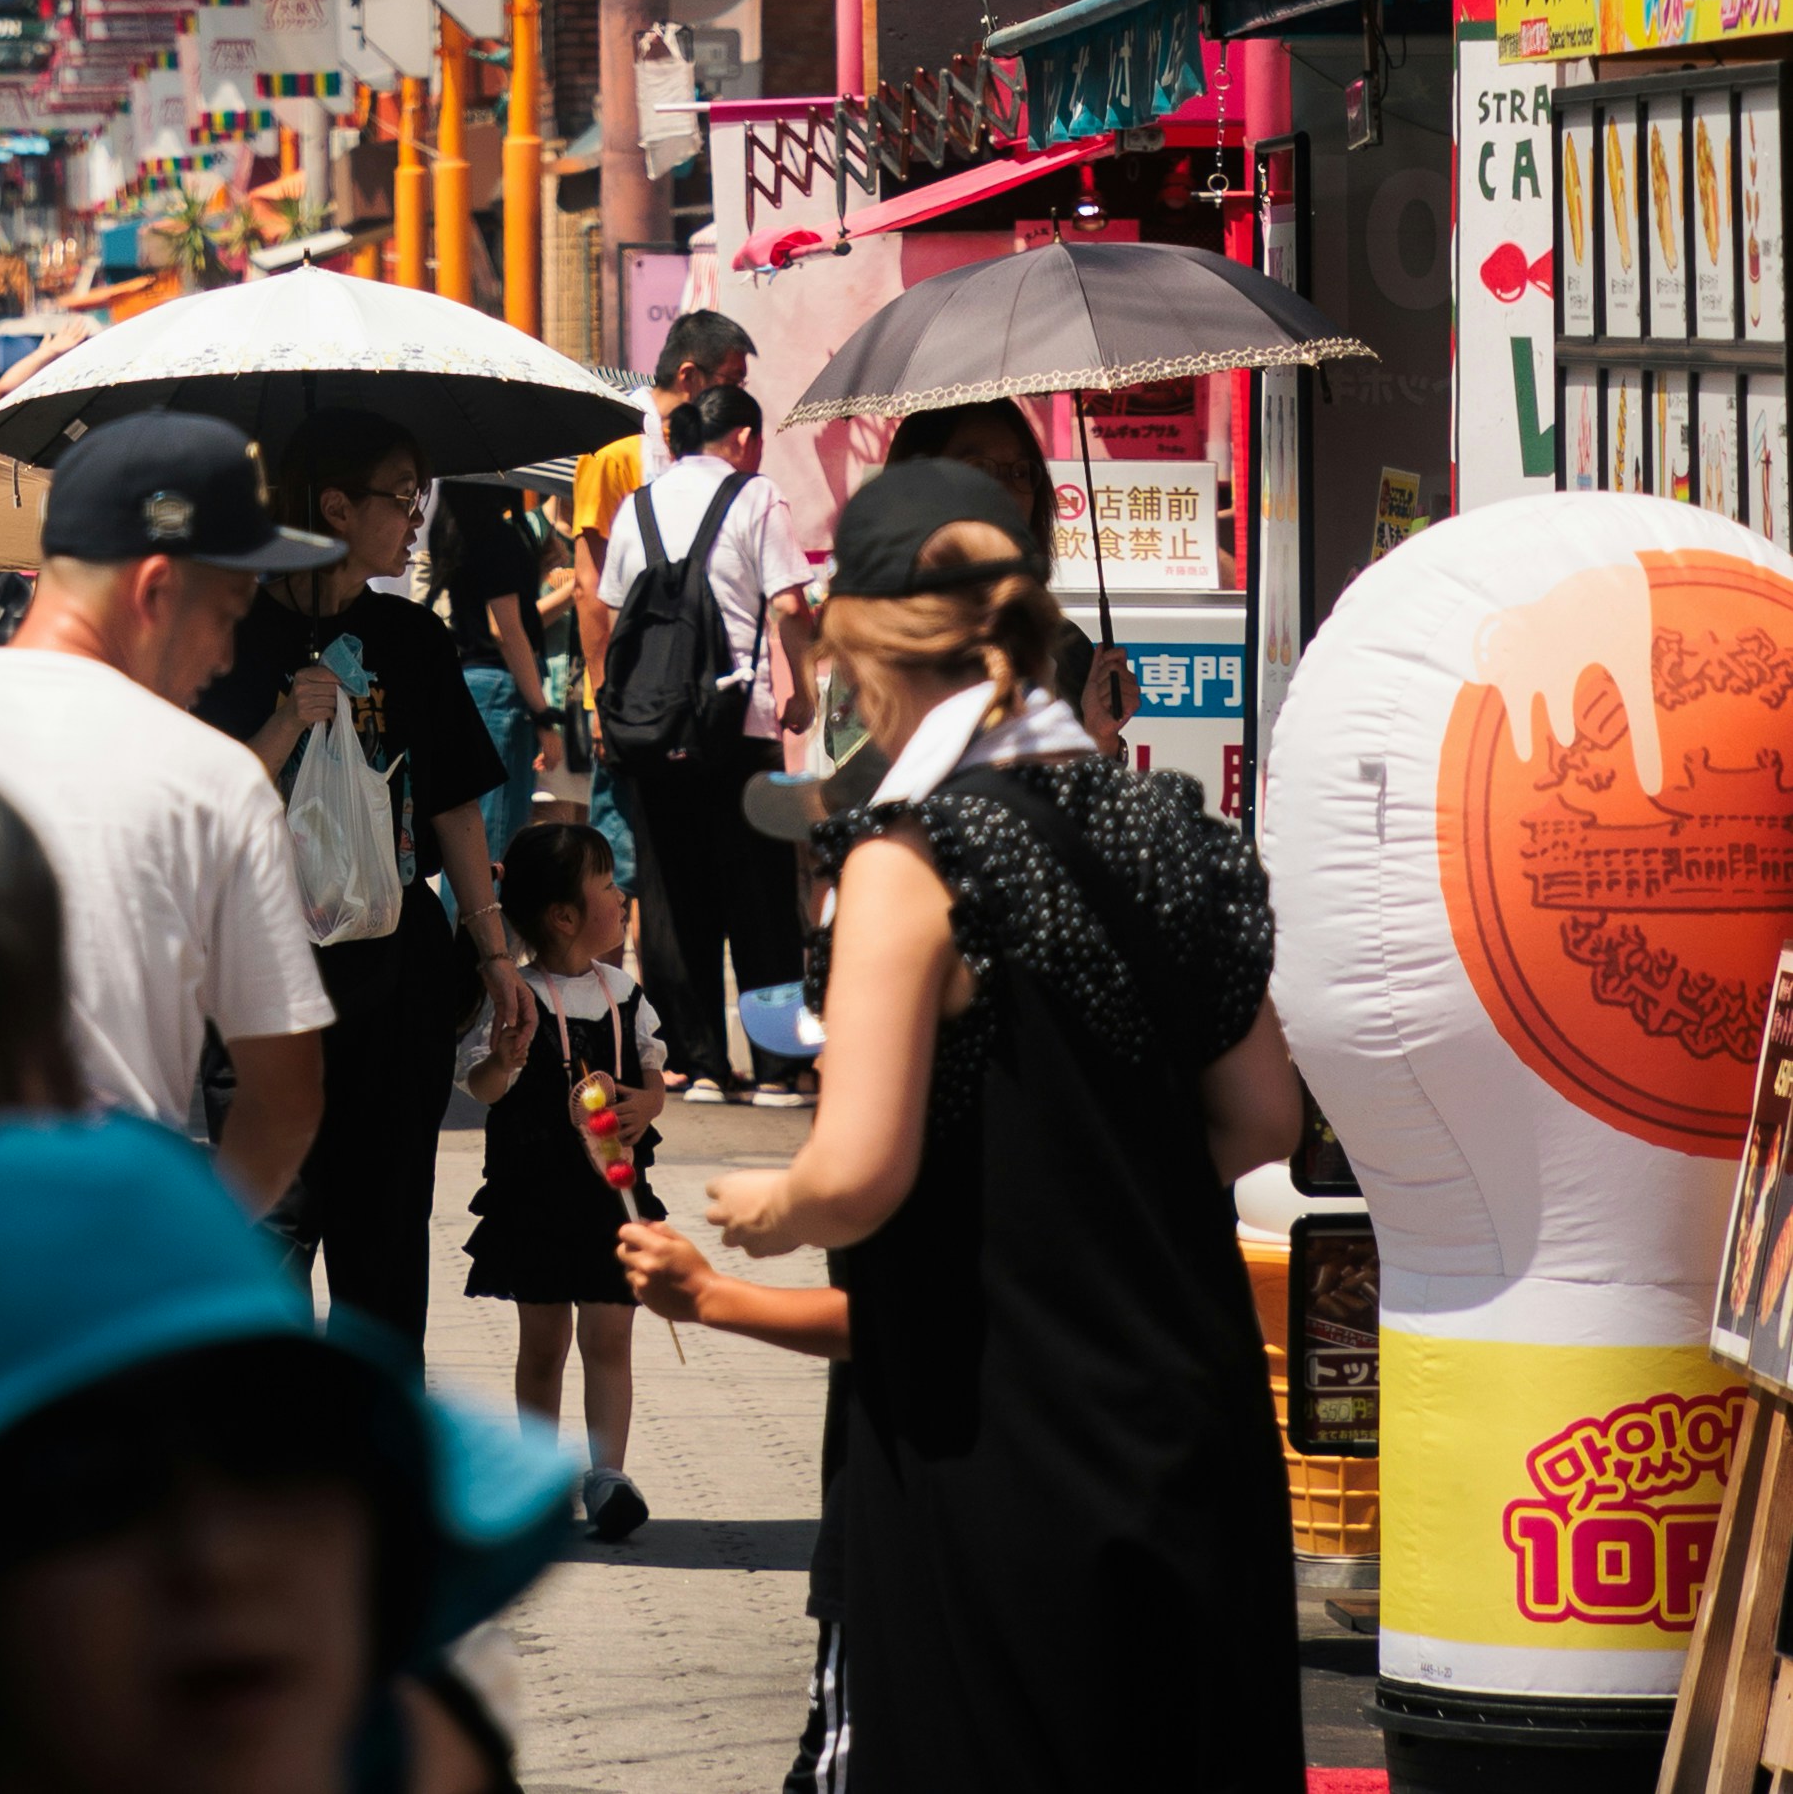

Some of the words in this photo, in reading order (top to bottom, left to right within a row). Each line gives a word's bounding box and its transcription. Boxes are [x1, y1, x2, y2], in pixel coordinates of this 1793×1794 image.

[1478, 84, 1552, 126] STRA
[1478, 138, 1542, 201] CA
[1093, 485, 1199, 522] 店舗前
[1056, 526, 1201, 561] 飲食禁止
